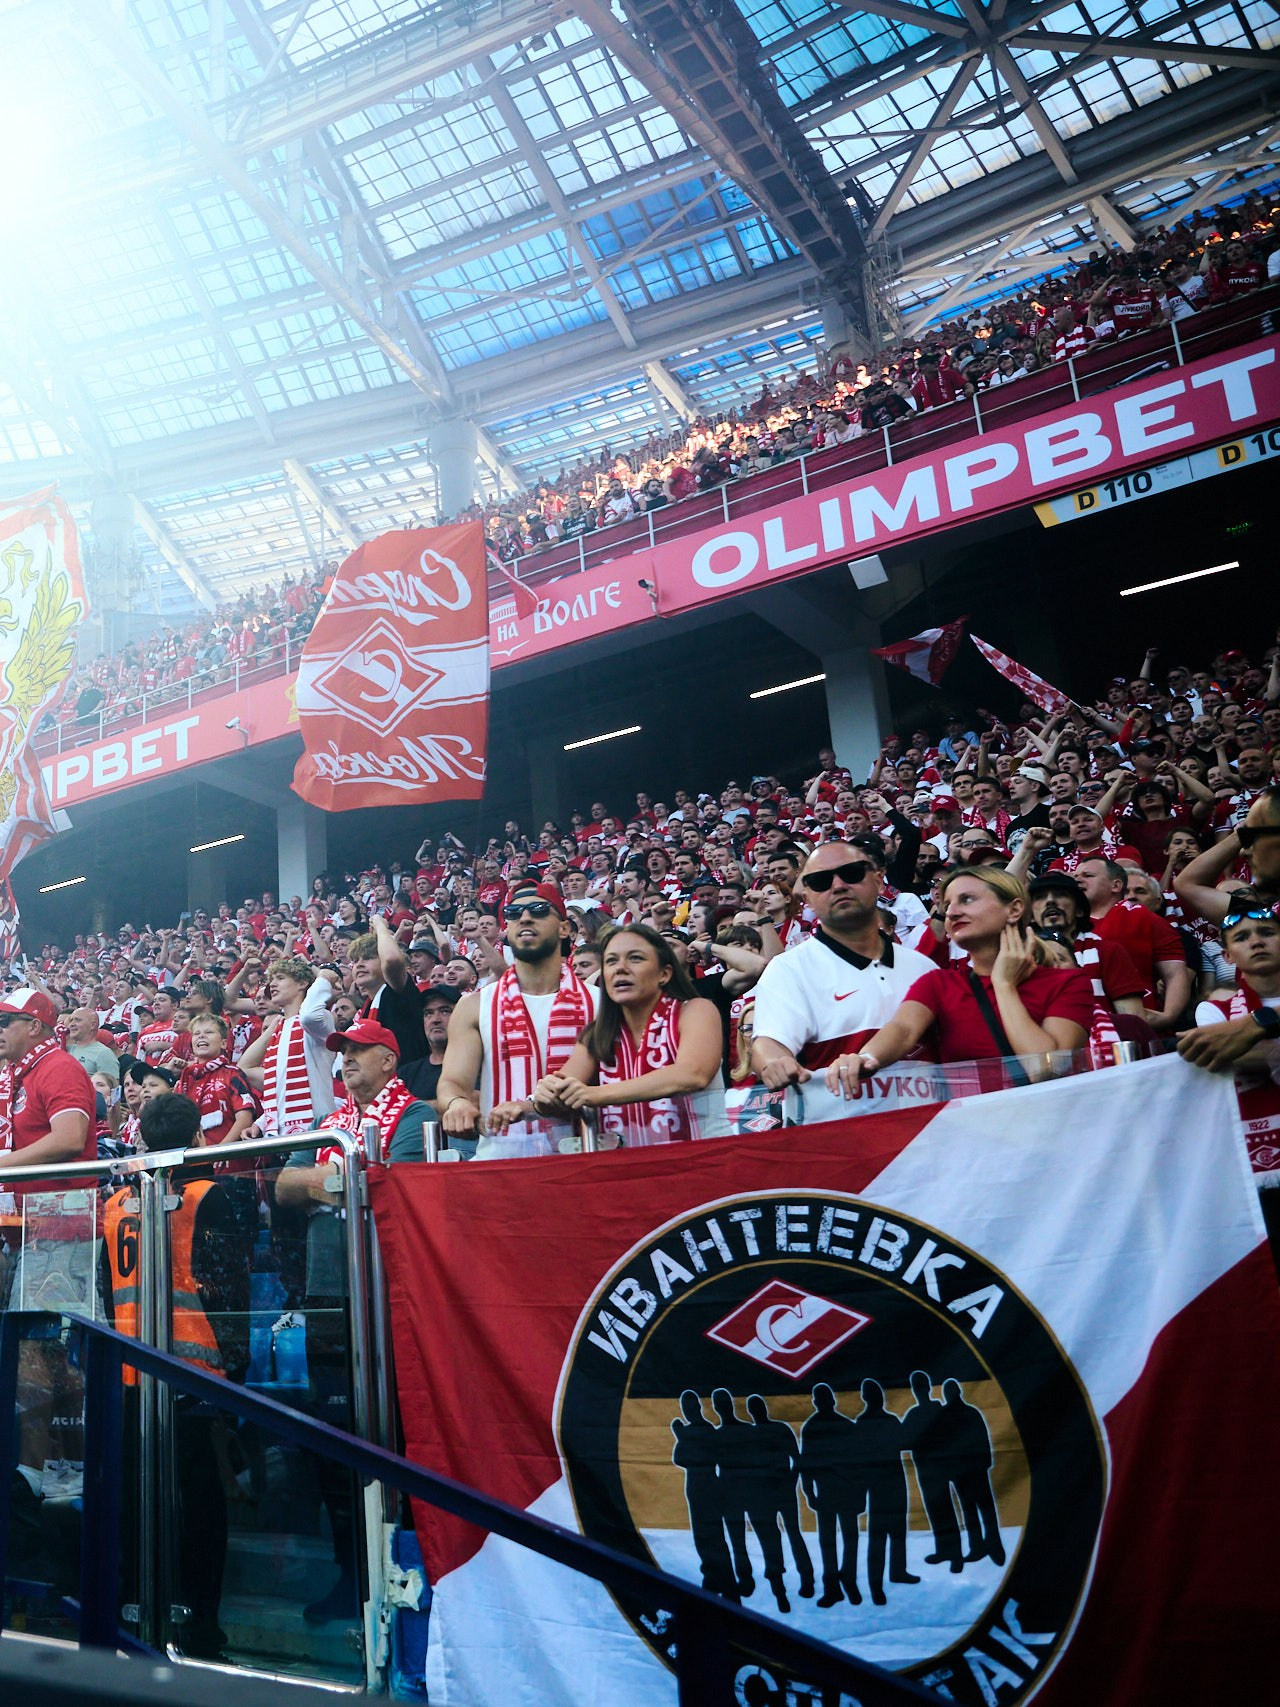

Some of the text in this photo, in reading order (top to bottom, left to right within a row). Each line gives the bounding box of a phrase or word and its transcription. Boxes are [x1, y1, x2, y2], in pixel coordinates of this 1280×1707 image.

[691, 348, 1275, 588] OLIMPBET
[1222, 445, 1241, 465] D
[1078, 491, 1095, 510] D
[1104, 471, 1152, 502] 110
[498, 581, 622, 642] НА ВОЛГЕ
[1248, 1120, 1269, 1131] 1922
[587, 1205, 1005, 1364] ИВАНТЕЕВКА
